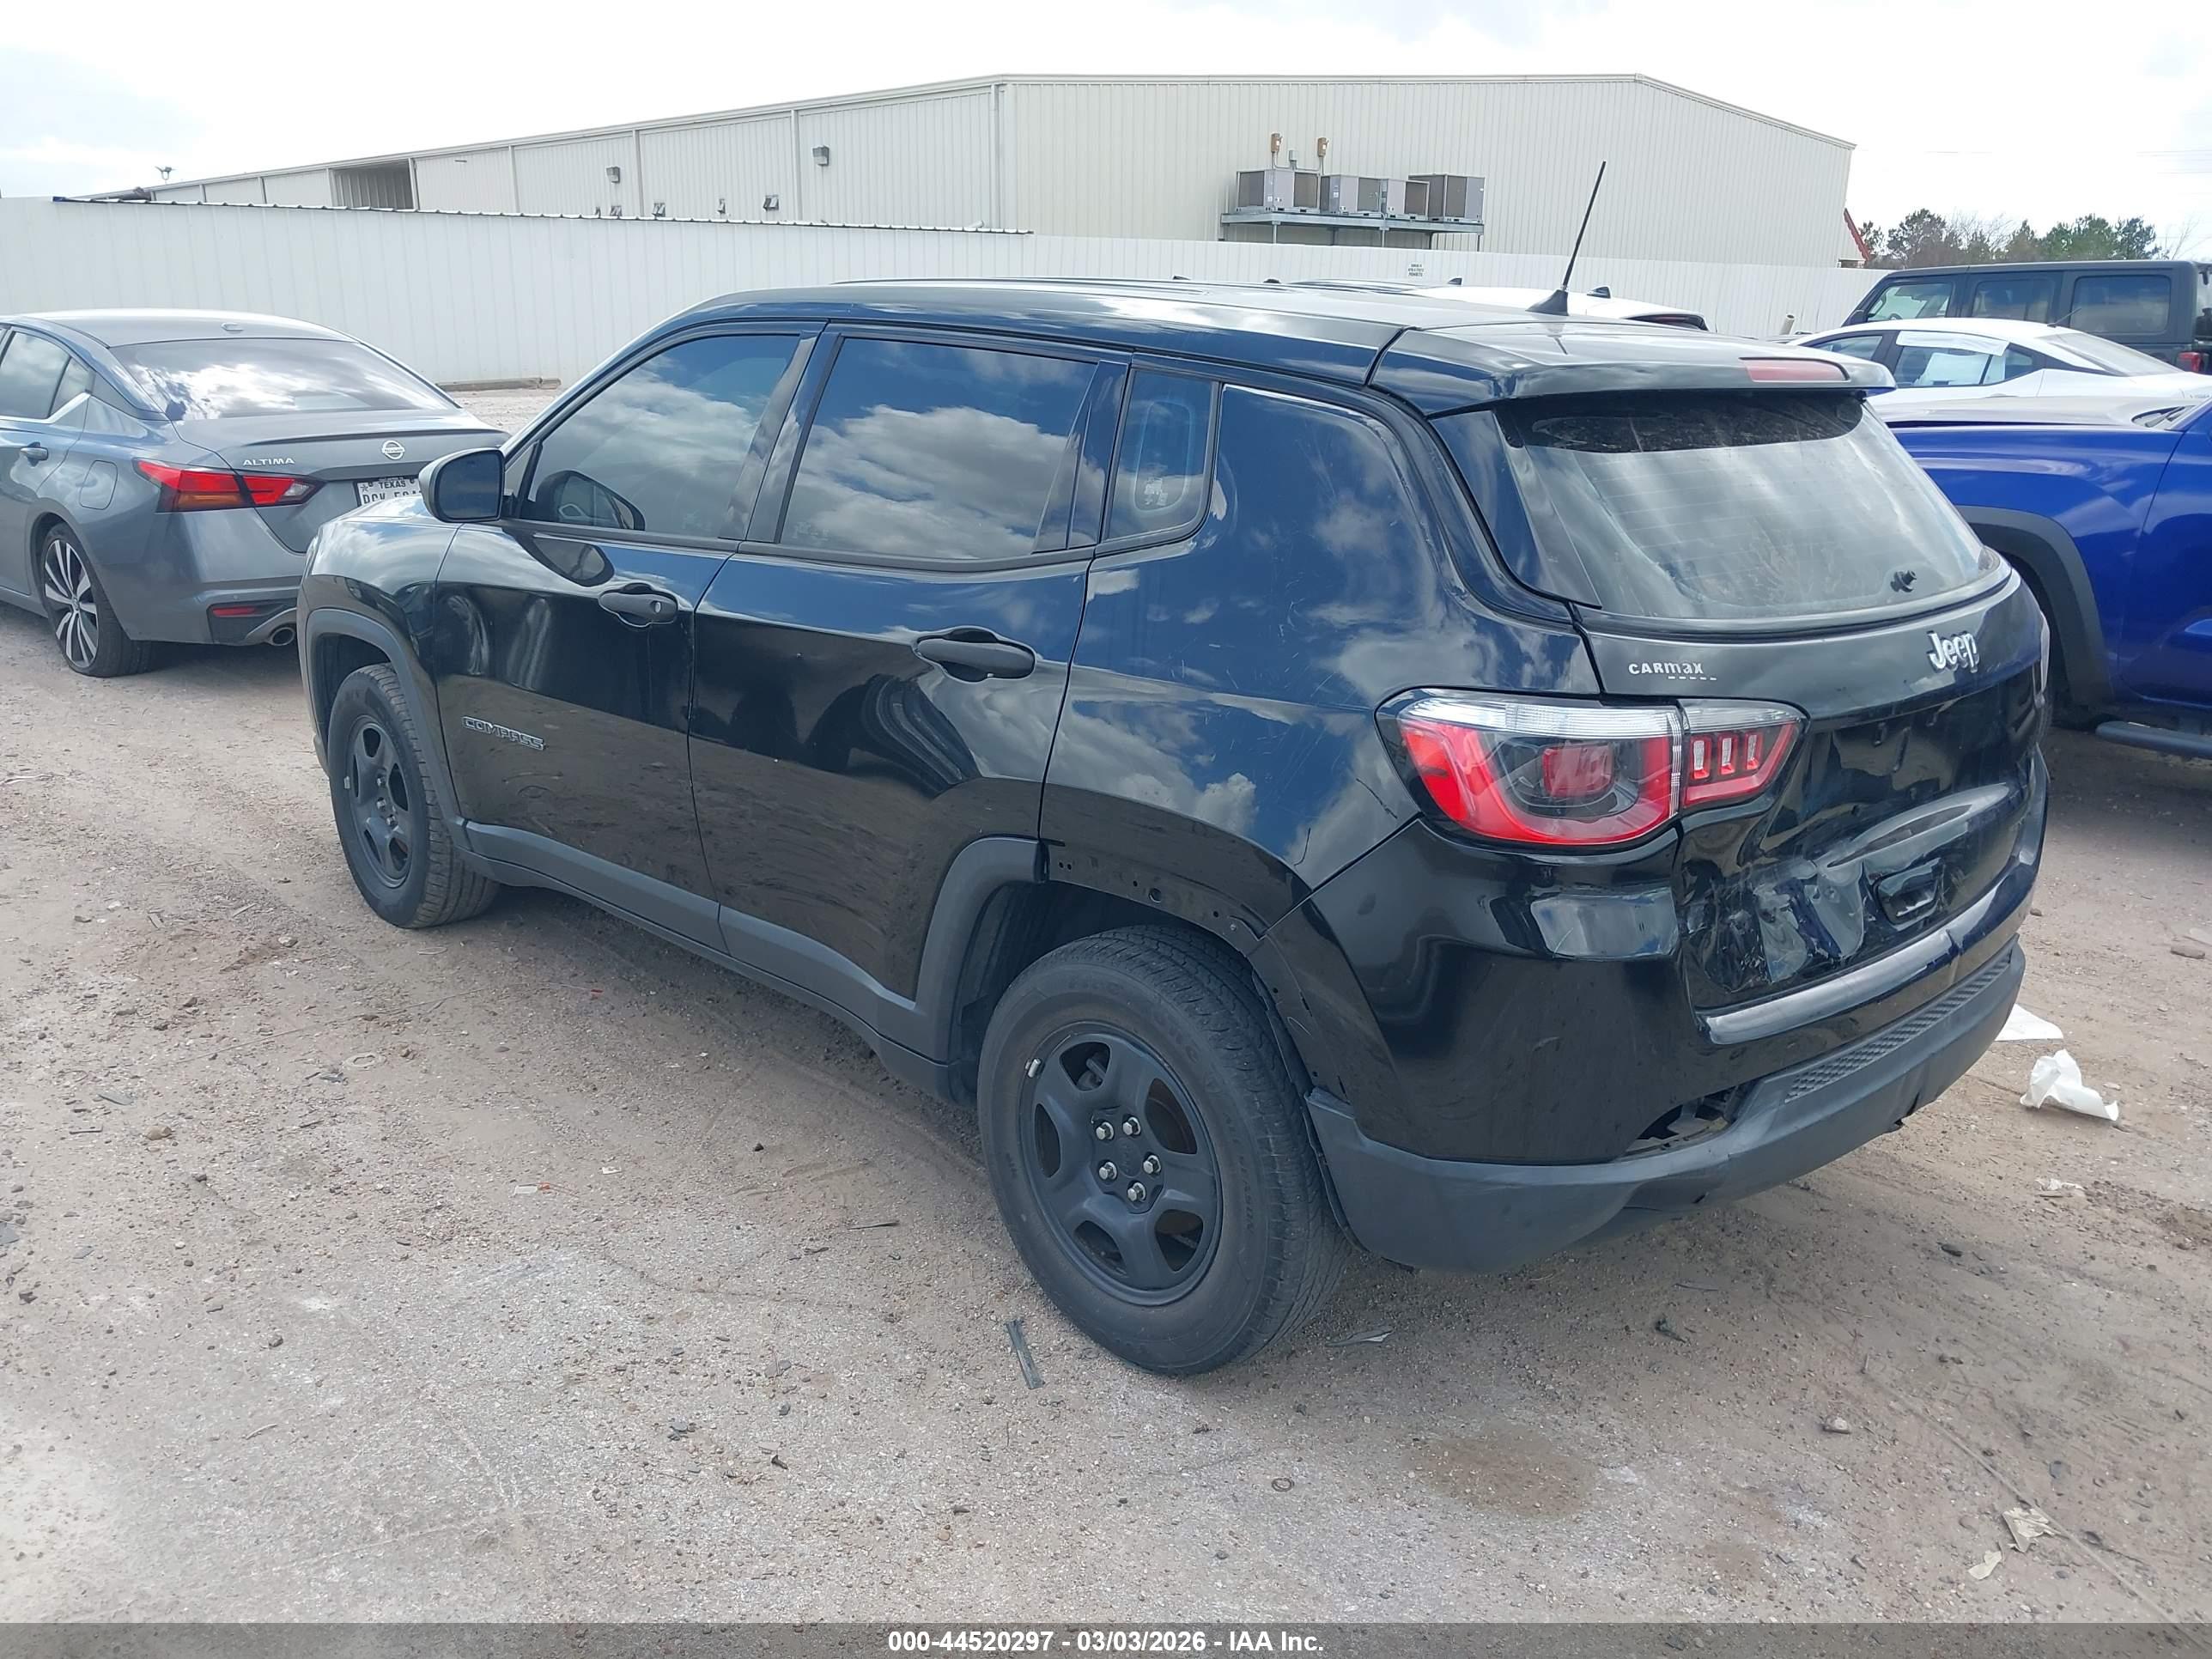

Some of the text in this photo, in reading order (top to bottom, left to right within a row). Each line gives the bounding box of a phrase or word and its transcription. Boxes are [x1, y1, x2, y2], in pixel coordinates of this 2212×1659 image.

[242, 458, 295, 466] ALTIMA
[379, 480, 406, 489] TEXAS
[1927, 631, 1978, 672] Jeep
[463, 715, 544, 750] COMPASS
